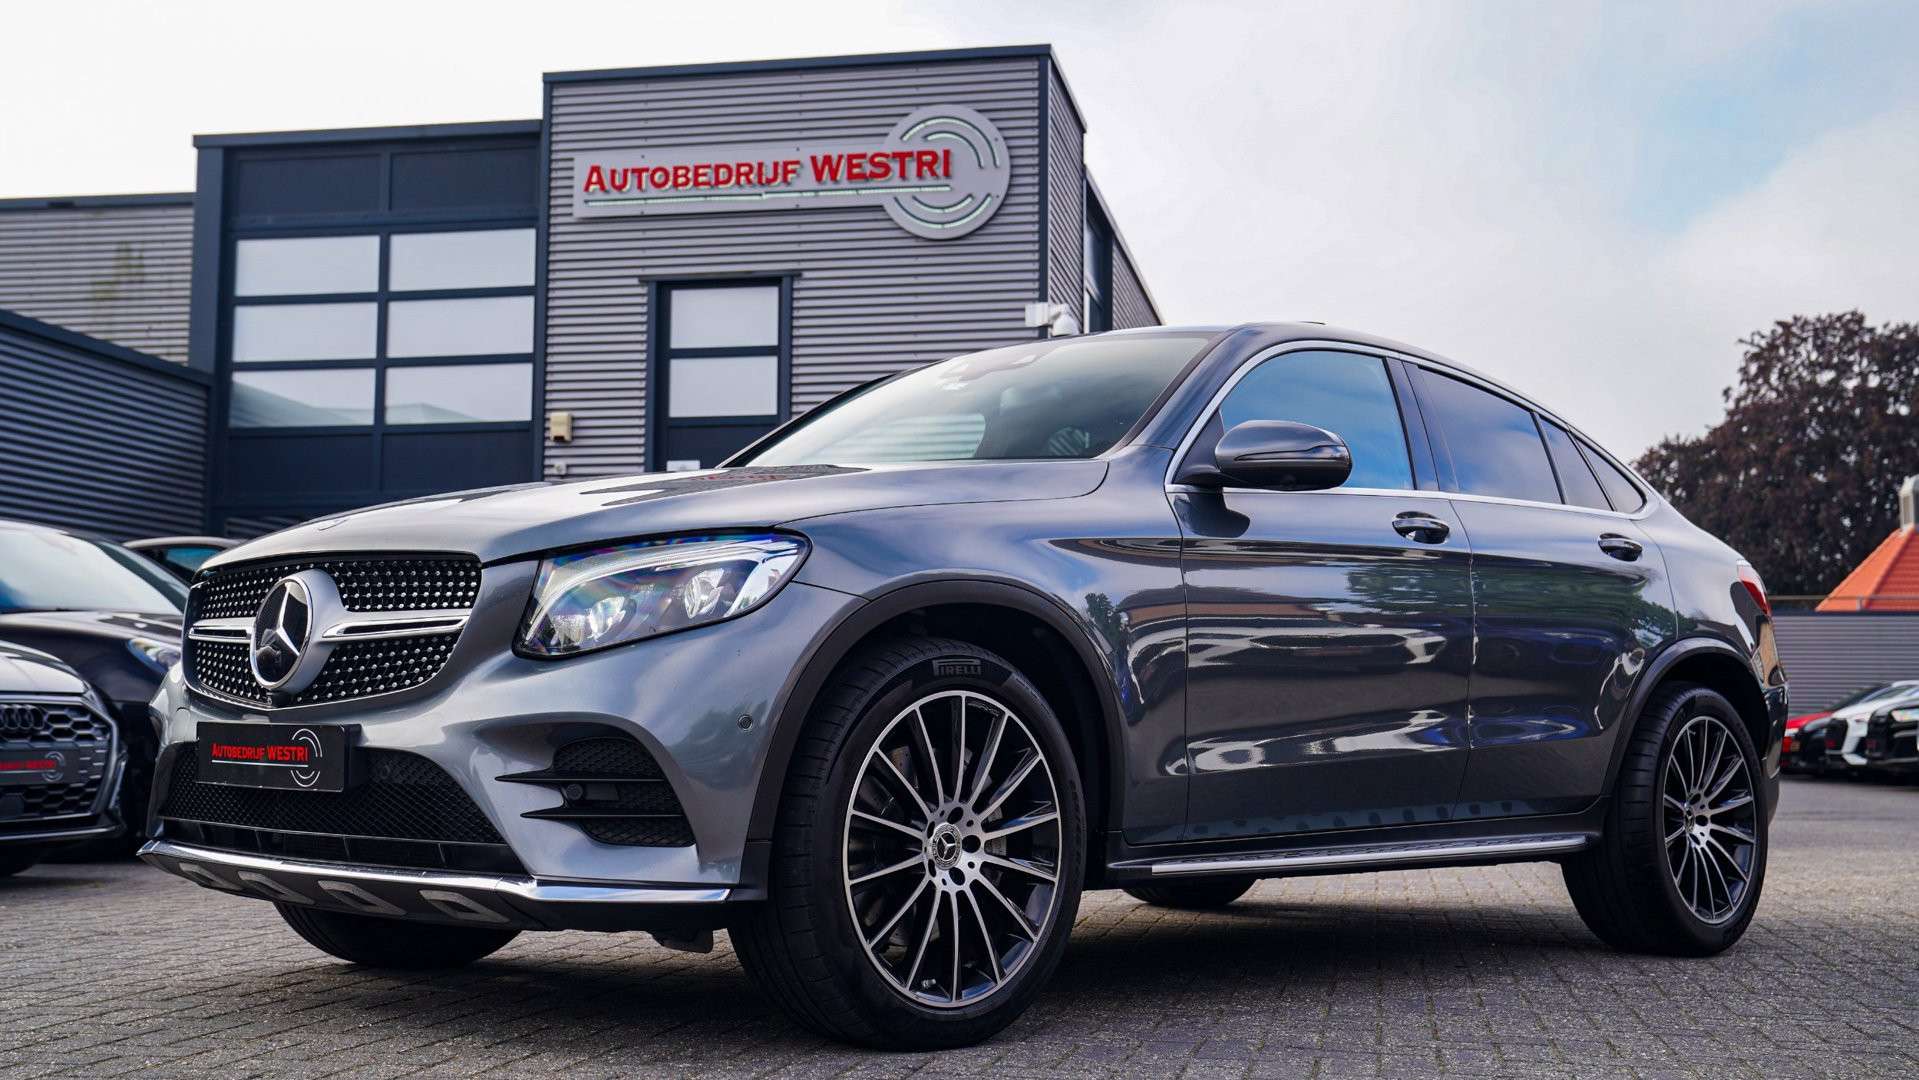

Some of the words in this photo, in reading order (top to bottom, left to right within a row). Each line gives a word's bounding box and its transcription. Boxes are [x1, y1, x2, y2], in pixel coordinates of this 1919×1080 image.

[584, 160, 801, 193] AUTOBEDRIJF
[810, 149, 951, 182] WESTRI
[932, 659, 981, 676] PIRELLI
[211, 743, 265, 760] AUTOBEDRIJF
[267, 746, 309, 762] WESTRI
